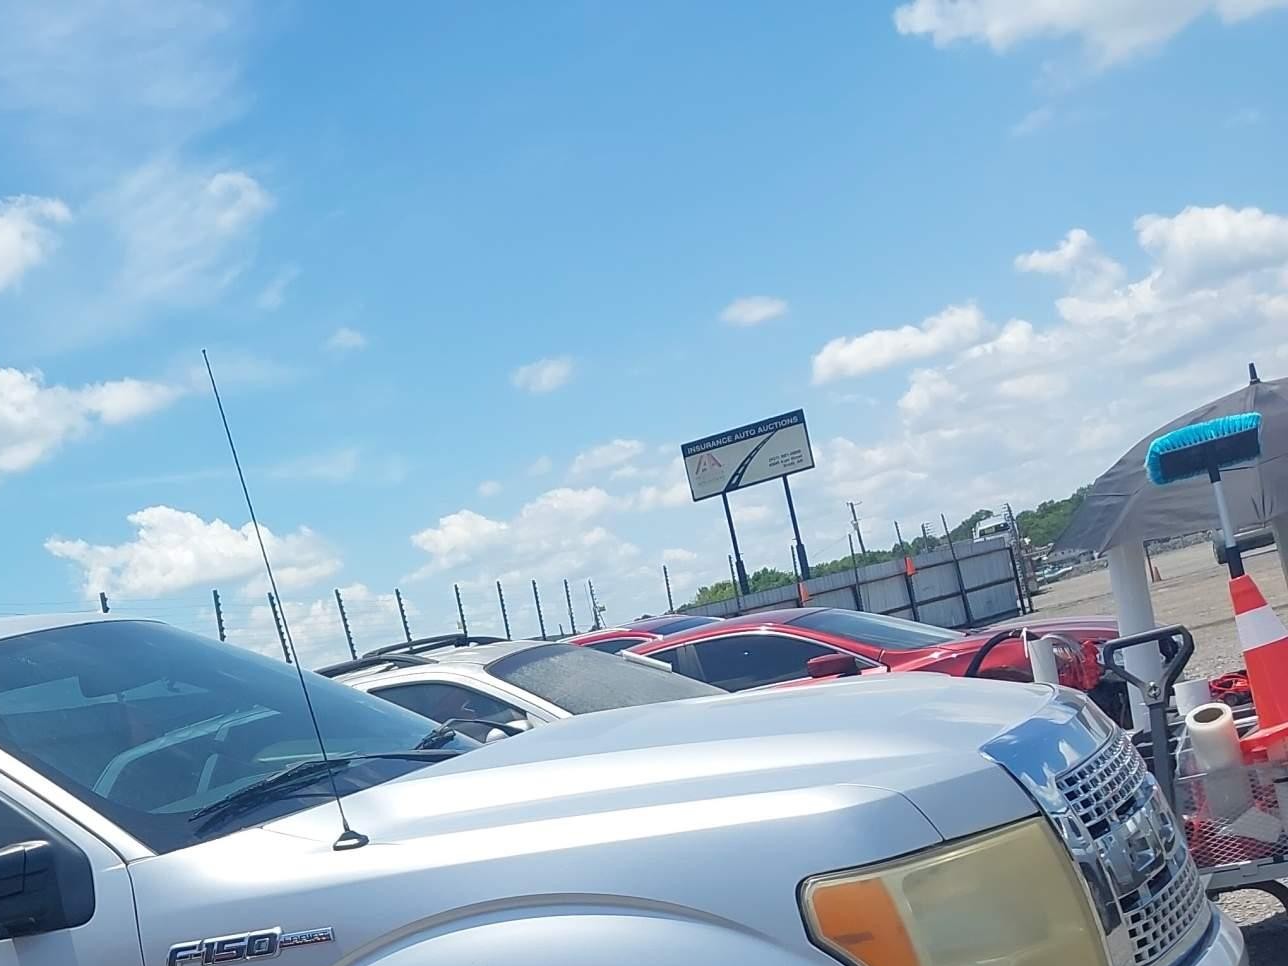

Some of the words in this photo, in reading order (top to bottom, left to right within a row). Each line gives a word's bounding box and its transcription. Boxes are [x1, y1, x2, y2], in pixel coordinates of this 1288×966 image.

[687, 435, 732, 455] INSURANCE
[734, 428, 756, 440] AUTO
[757, 415, 799, 434] AUCTIONS
